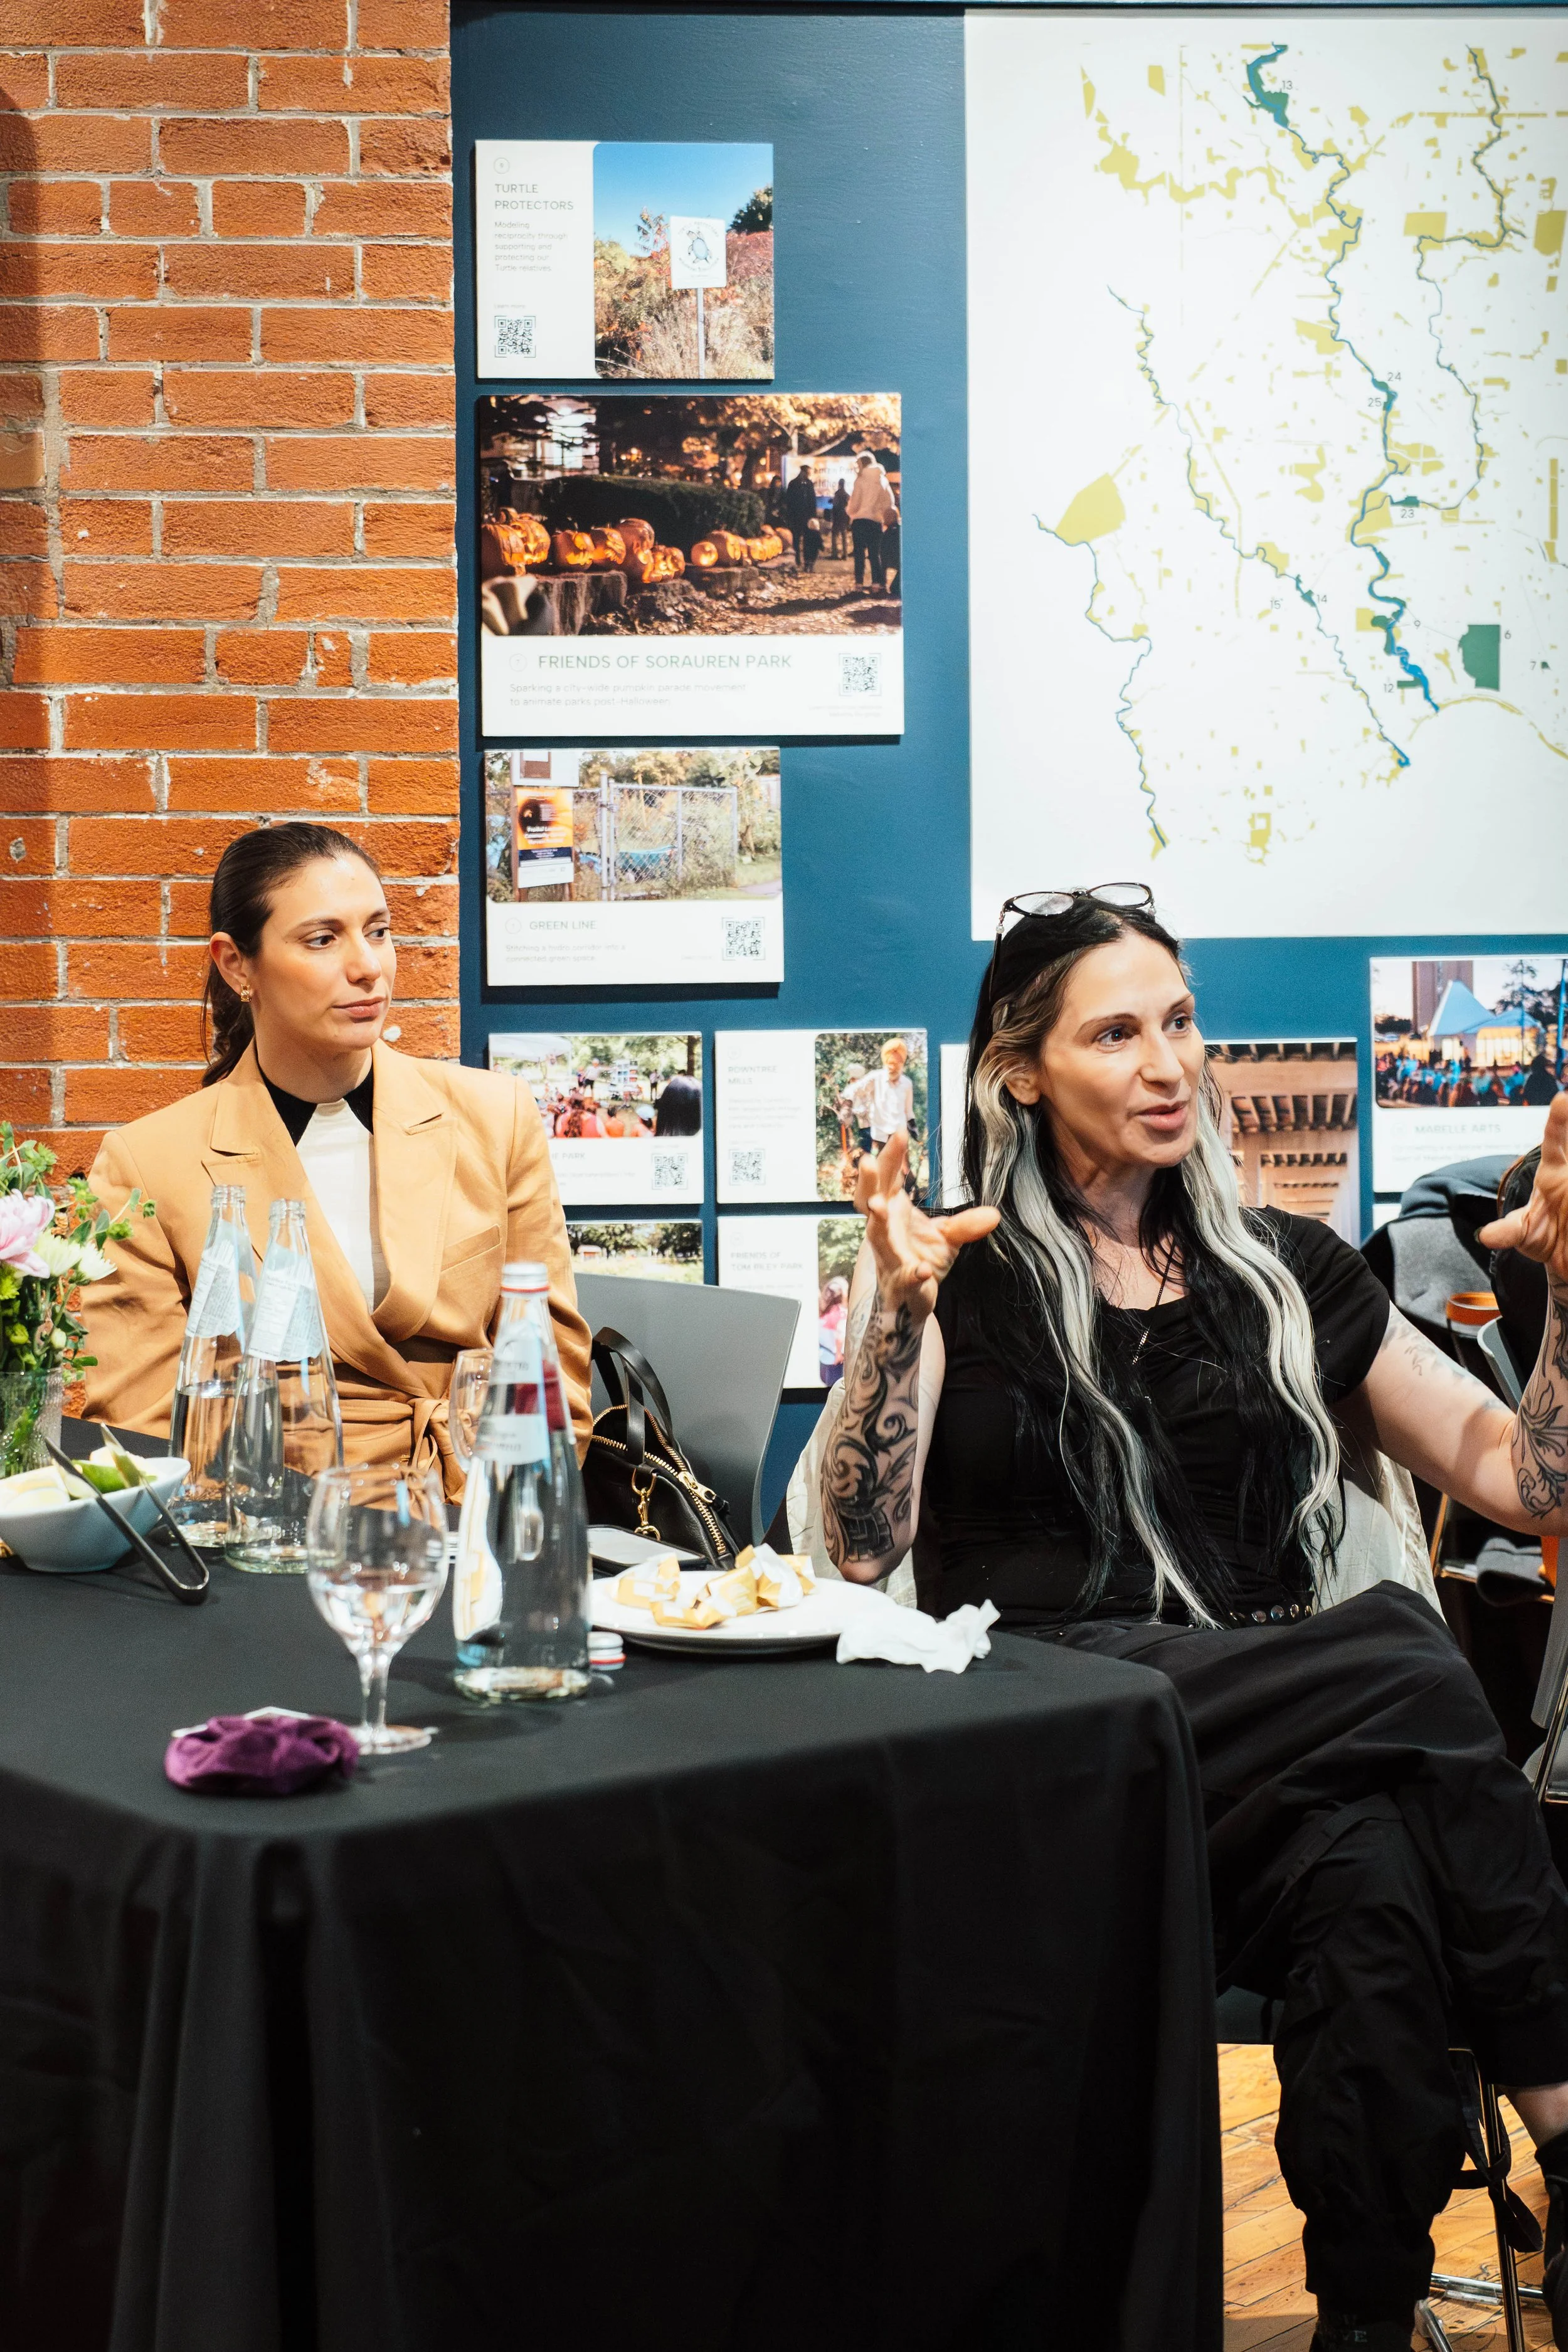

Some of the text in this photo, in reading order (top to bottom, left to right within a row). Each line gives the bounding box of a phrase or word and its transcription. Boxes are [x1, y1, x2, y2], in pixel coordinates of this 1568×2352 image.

[1282, 80, 1293, 90] 13
[494, 183, 539, 194] TURTLE
[494, 199, 574, 211] PROTECTORS
[494, 221, 530, 230] Modeling
[494, 232, 568, 241] reciprocity through
[494, 243, 536, 252] supporting
[494, 254, 534, 262] protecting
[495, 263, 517, 272] Turtle
[1387, 371, 1402, 382] 24
[1367, 397, 1382, 408] 25
[1401, 509, 1415, 519] 23
[1316, 594, 1327, 603] 14
[1413, 620, 1421, 630] 9
[1504, 629, 1512, 640] 6
[538, 654, 792, 669] FRIENDS OF SORAUREN PARK
[1530, 660, 1537, 670] 7
[509, 684, 553, 694] Sparking
[564, 684, 610, 693] city-wide
[613, 684, 655, 693] pumpkin
[658, 684, 691, 692] parade
[1383, 683, 1394, 693] 12
[510, 698, 520, 706] to
[522, 698, 562, 706] animate
[564, 697, 591, 707] parks
[529, 919, 598, 930] GREEN LINE
[727, 1066, 778, 1074] ROWNTREE
[1414, 1124, 1468, 1135] MABELLE
[1471, 1123, 1502, 1134] ARTS
[730, 1251, 767, 1260] FRIENDS
[780, 1262, 803, 1271] PARK
